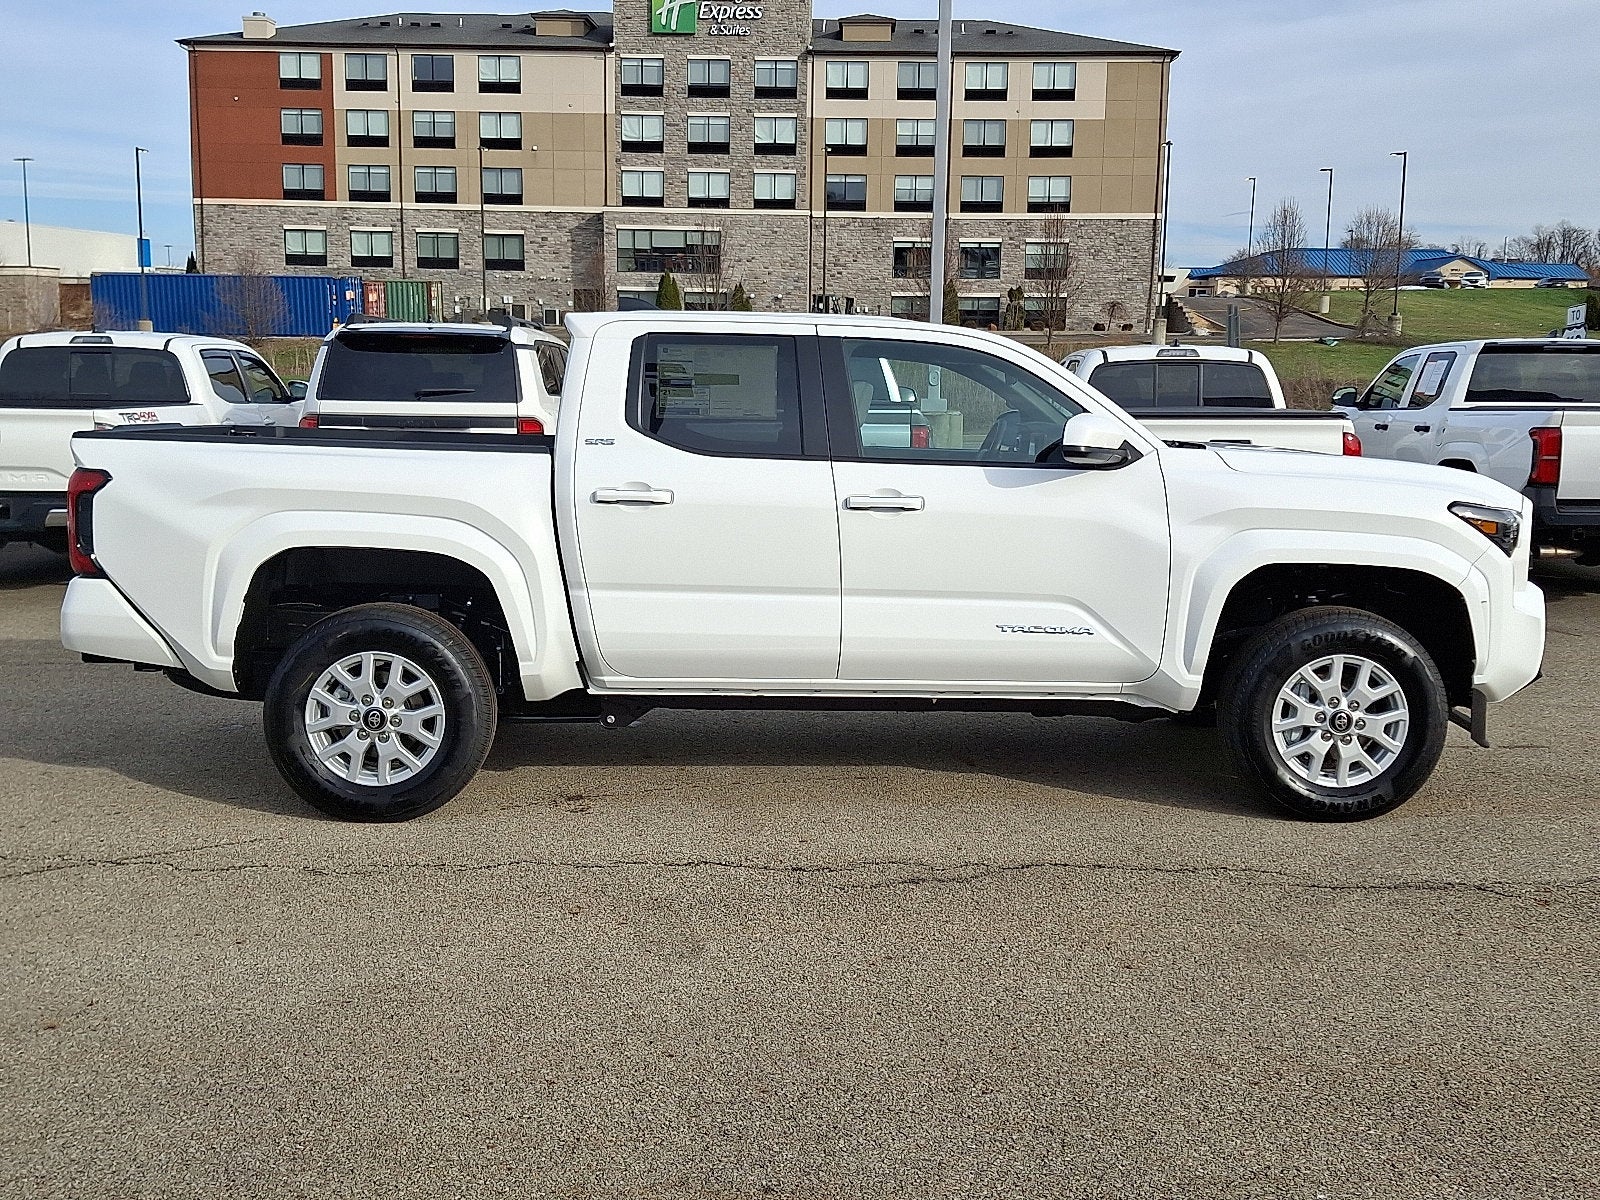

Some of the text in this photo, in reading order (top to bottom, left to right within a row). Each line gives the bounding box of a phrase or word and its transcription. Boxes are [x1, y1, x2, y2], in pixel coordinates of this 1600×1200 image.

[699, 1, 763, 23] Express
[710, 25, 751, 36] & Suites
[1571, 309, 1581, 321] TO
[996, 624, 1094, 635] TACOMA
